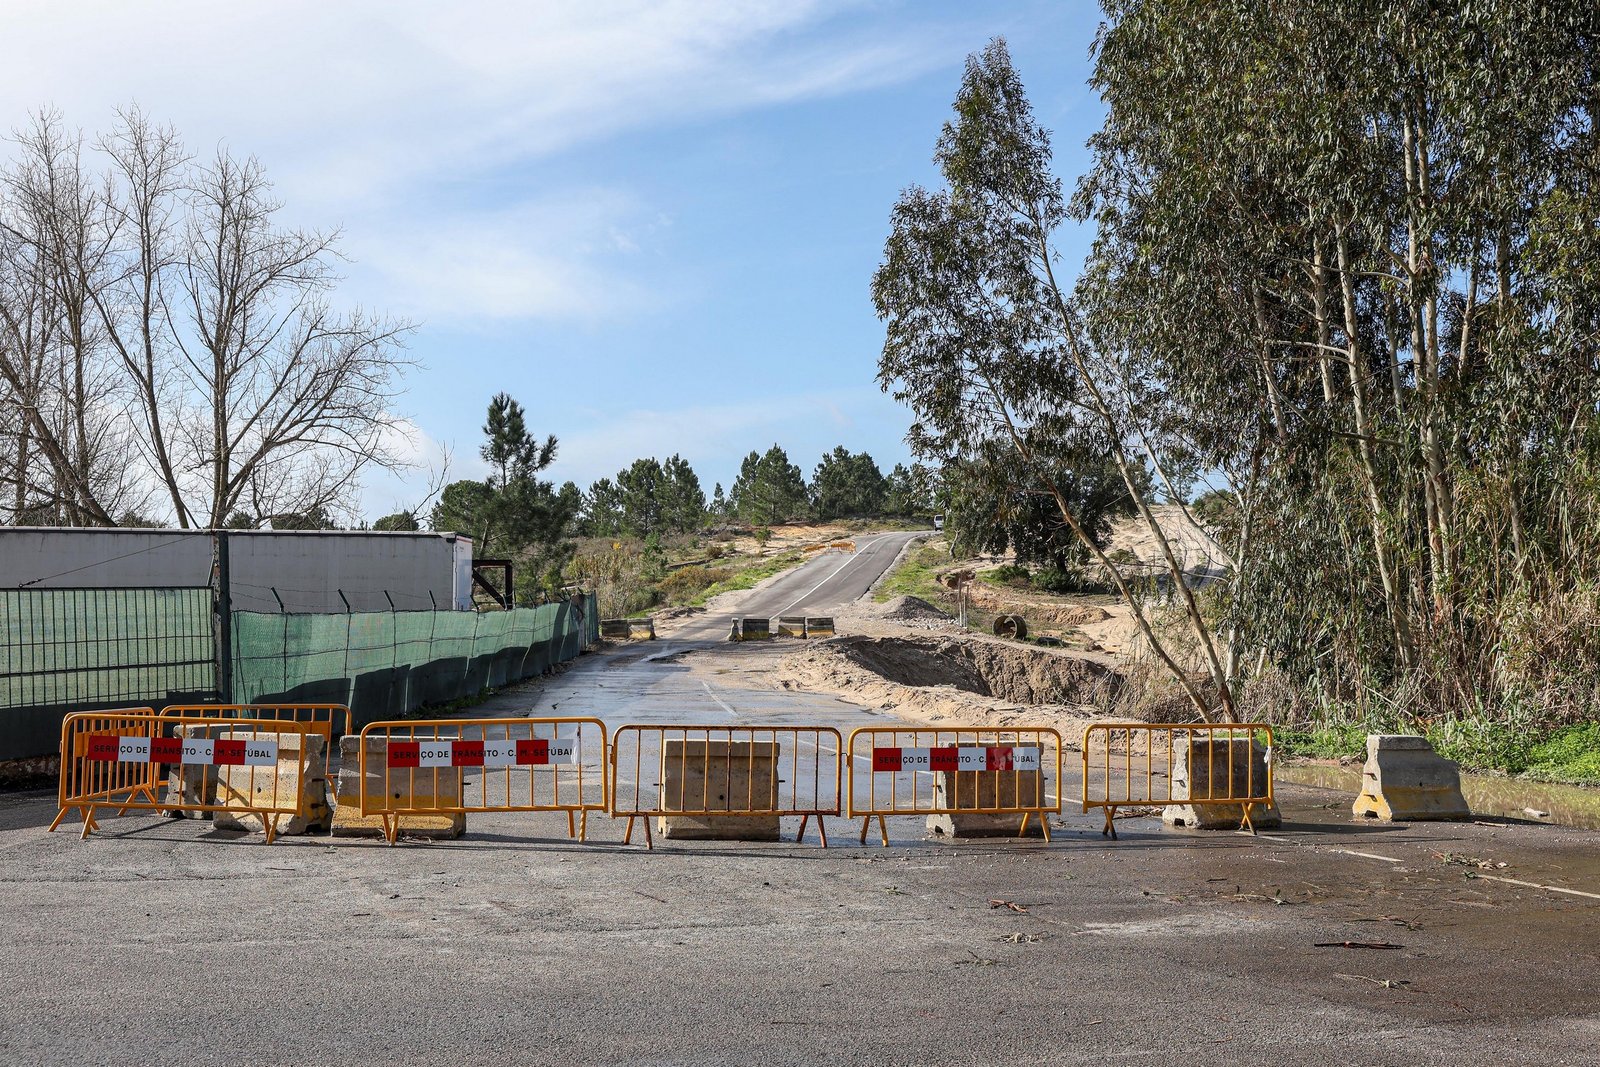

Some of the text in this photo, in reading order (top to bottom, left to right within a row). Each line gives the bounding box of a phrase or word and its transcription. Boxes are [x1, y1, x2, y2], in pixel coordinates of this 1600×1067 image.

[94, 745, 133, 754] SERVIÇO
[136, 746, 148, 754] DE
[230, 748, 271, 758] SETÚBAL
[393, 751, 434, 760] SERVIÇO
[437, 750, 449, 758] DE
[879, 756, 914, 765] SERVIÇO
[917, 756, 928, 764] DE
